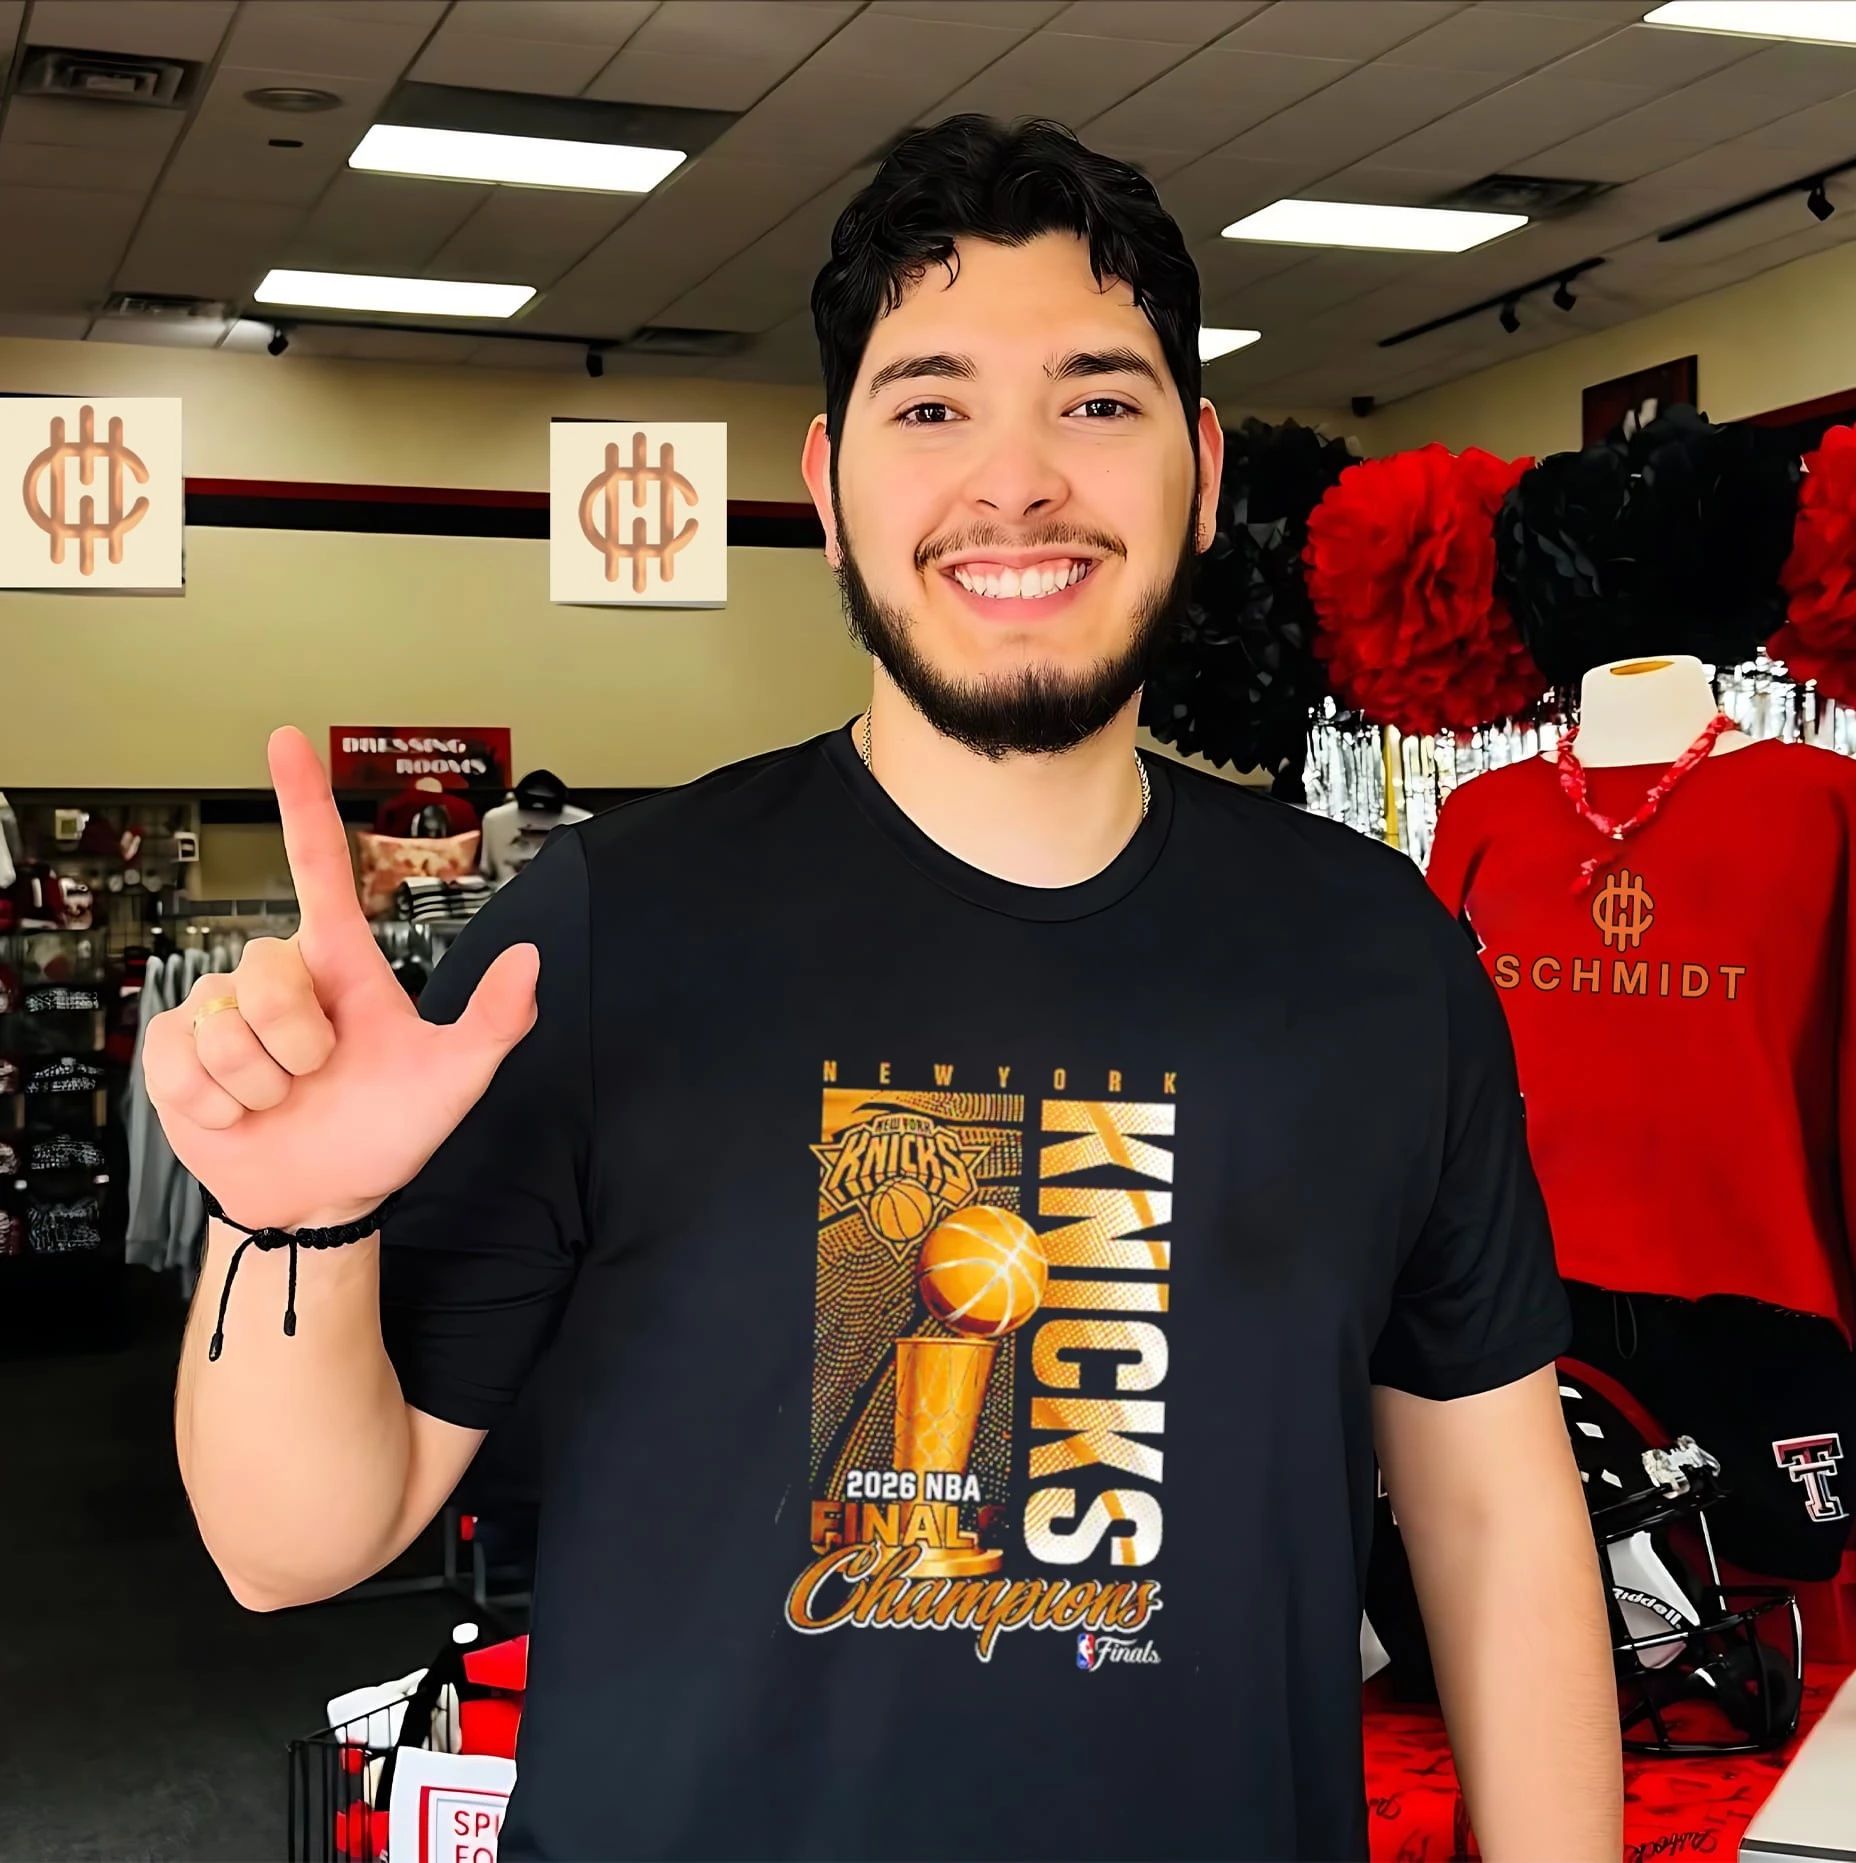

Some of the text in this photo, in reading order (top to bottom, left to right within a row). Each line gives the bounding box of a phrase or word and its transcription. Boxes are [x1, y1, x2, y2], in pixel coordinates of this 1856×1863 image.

[342, 736, 467, 754] DRESSING
[396, 757, 487, 775] ROOMS
[1494, 954, 1747, 1000] SCHMIDT
[875, 1118, 932, 1135] NEW YORK
[828, 1130, 970, 1203] KNICKS
[1023, 1099, 1177, 1567] KNICKS
[846, 1469, 981, 1503] 2026 NBA
[784, 1544, 1164, 1663] Champions
[1089, 1635, 1162, 1672] Finals
